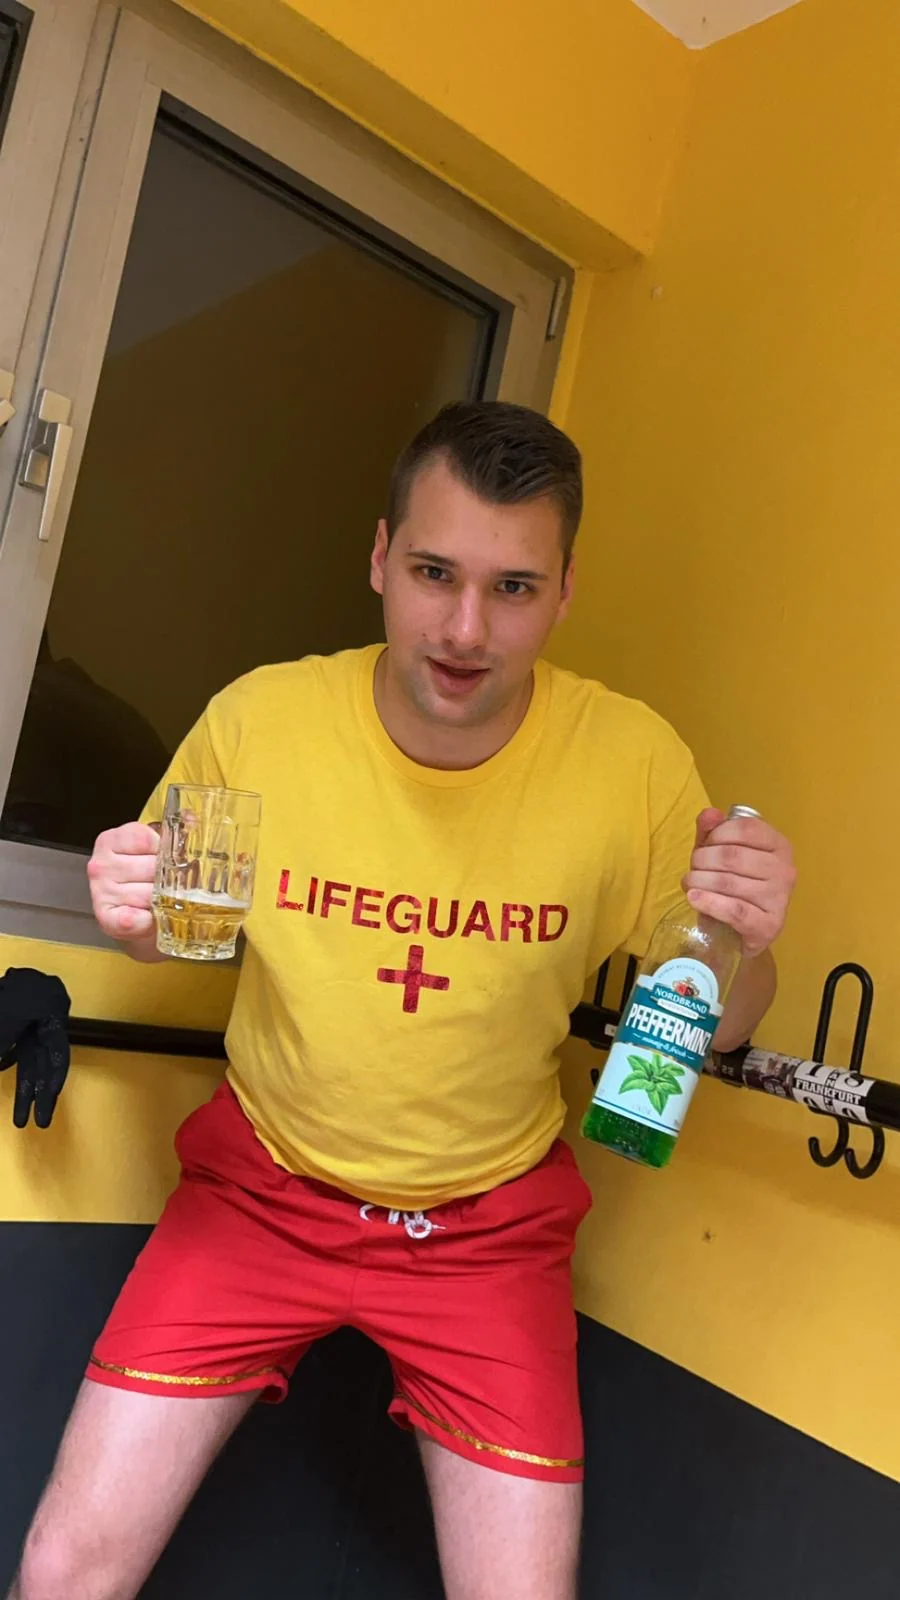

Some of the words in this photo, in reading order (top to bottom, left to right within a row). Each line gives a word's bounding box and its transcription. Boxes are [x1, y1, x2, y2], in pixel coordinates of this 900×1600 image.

[275, 869, 569, 943] LIFEGUARD
[655, 987, 708, 1014] NORDBRAND
[625, 1003, 712, 1057] PFEFFERMINZ
[795, 1079, 862, 1105] FRANKFURT
